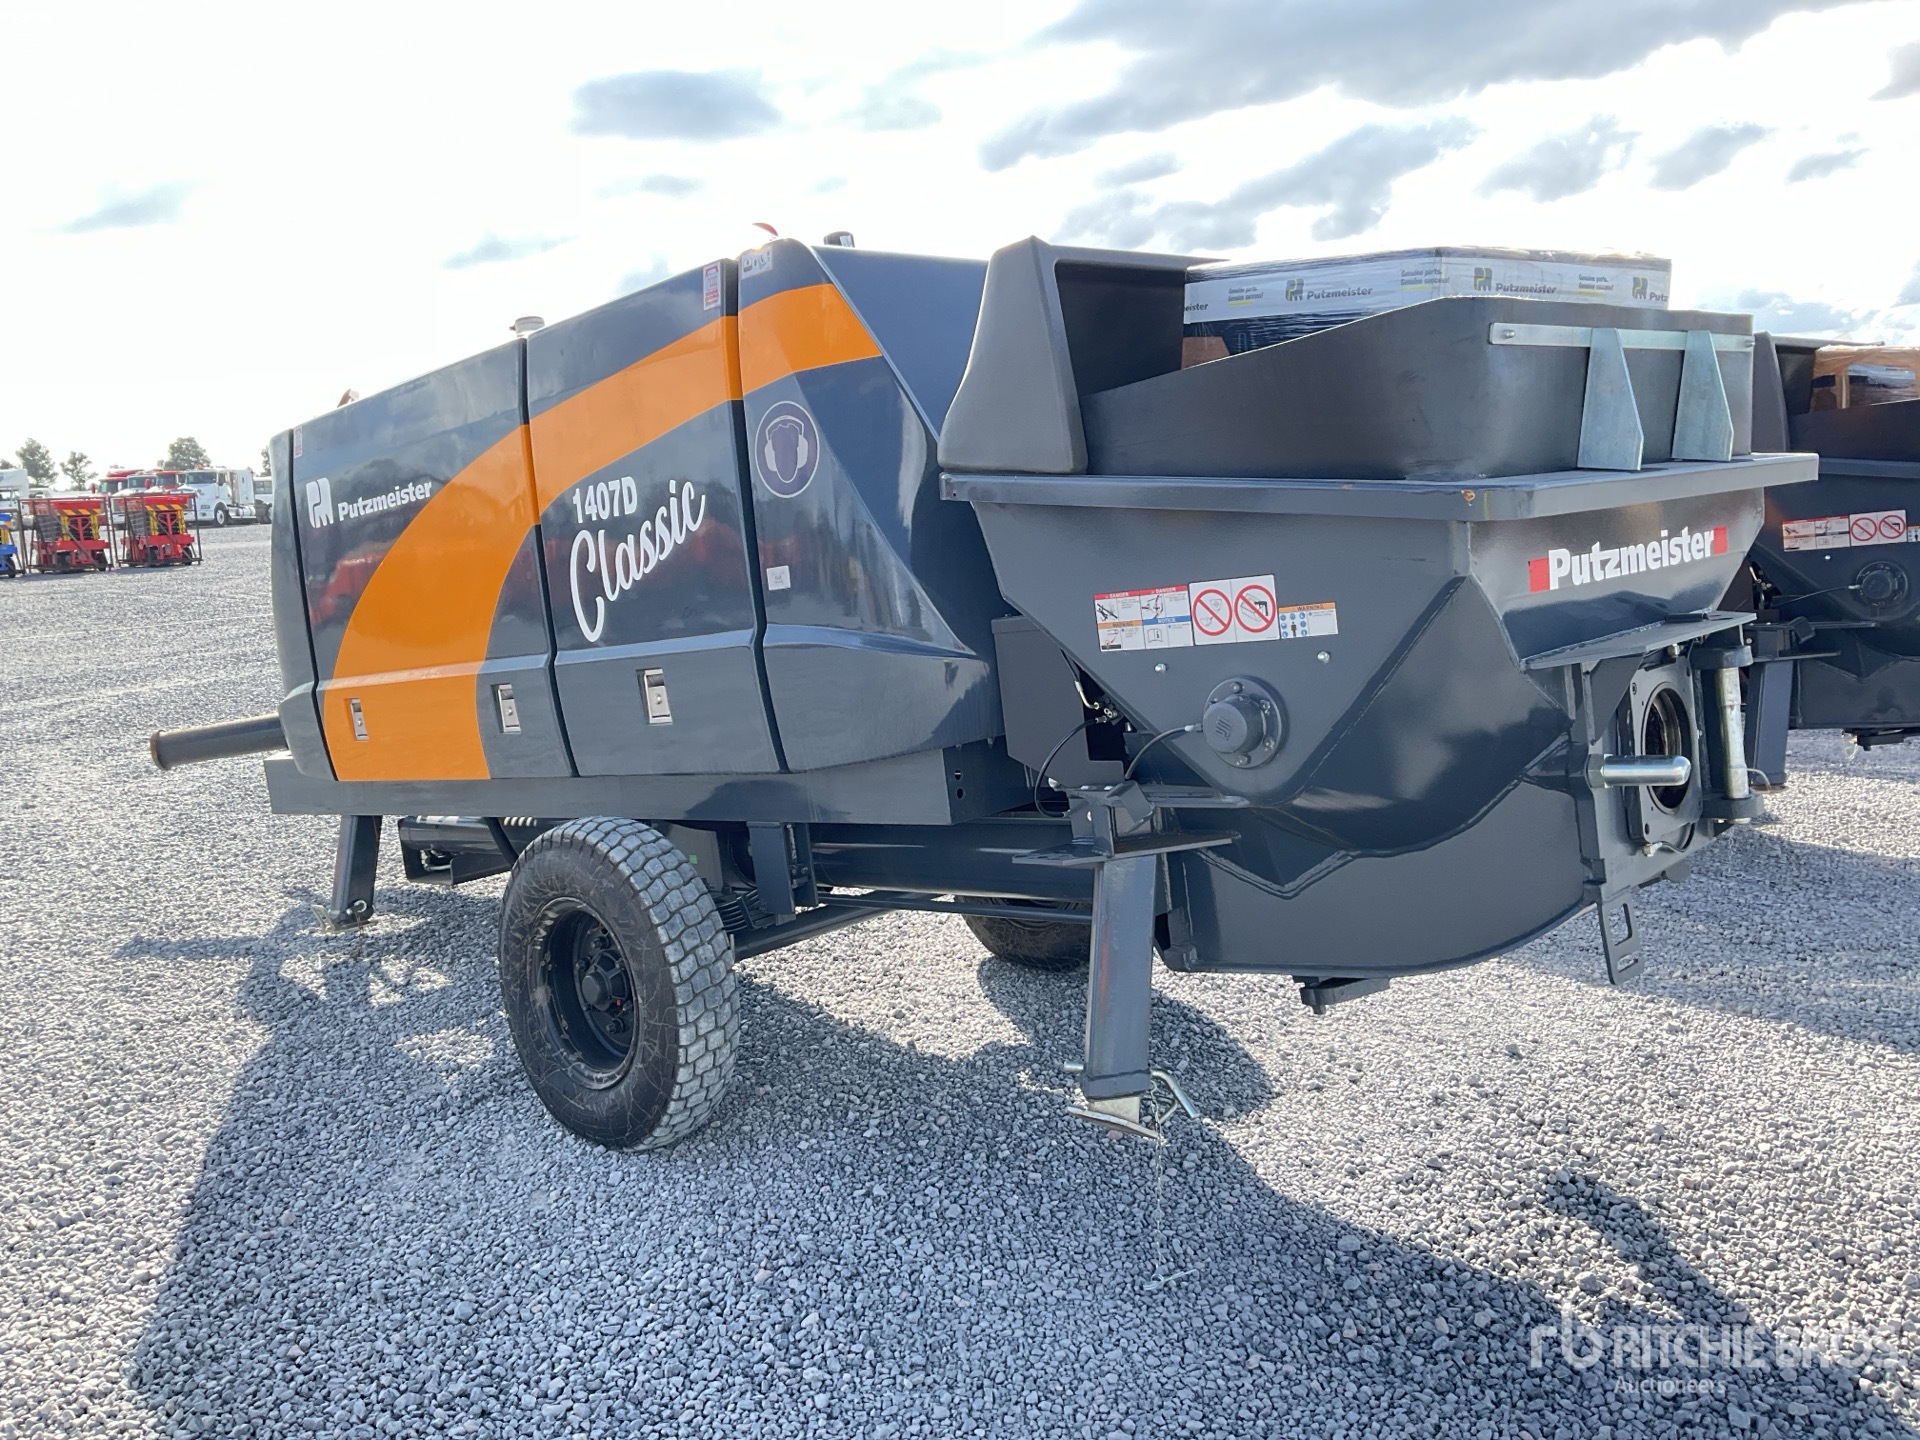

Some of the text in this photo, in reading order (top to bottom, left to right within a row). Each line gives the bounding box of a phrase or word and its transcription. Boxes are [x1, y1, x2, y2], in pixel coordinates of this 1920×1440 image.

[1306, 287, 1373, 300] Putzmeister
[1495, 282, 1557, 294] Putzmeister
[338, 482, 432, 521] Putzmeister
[573, 476, 638, 523] 1407D
[570, 480, 706, 642] Classic
[1548, 526, 1714, 590] Putzmeister
